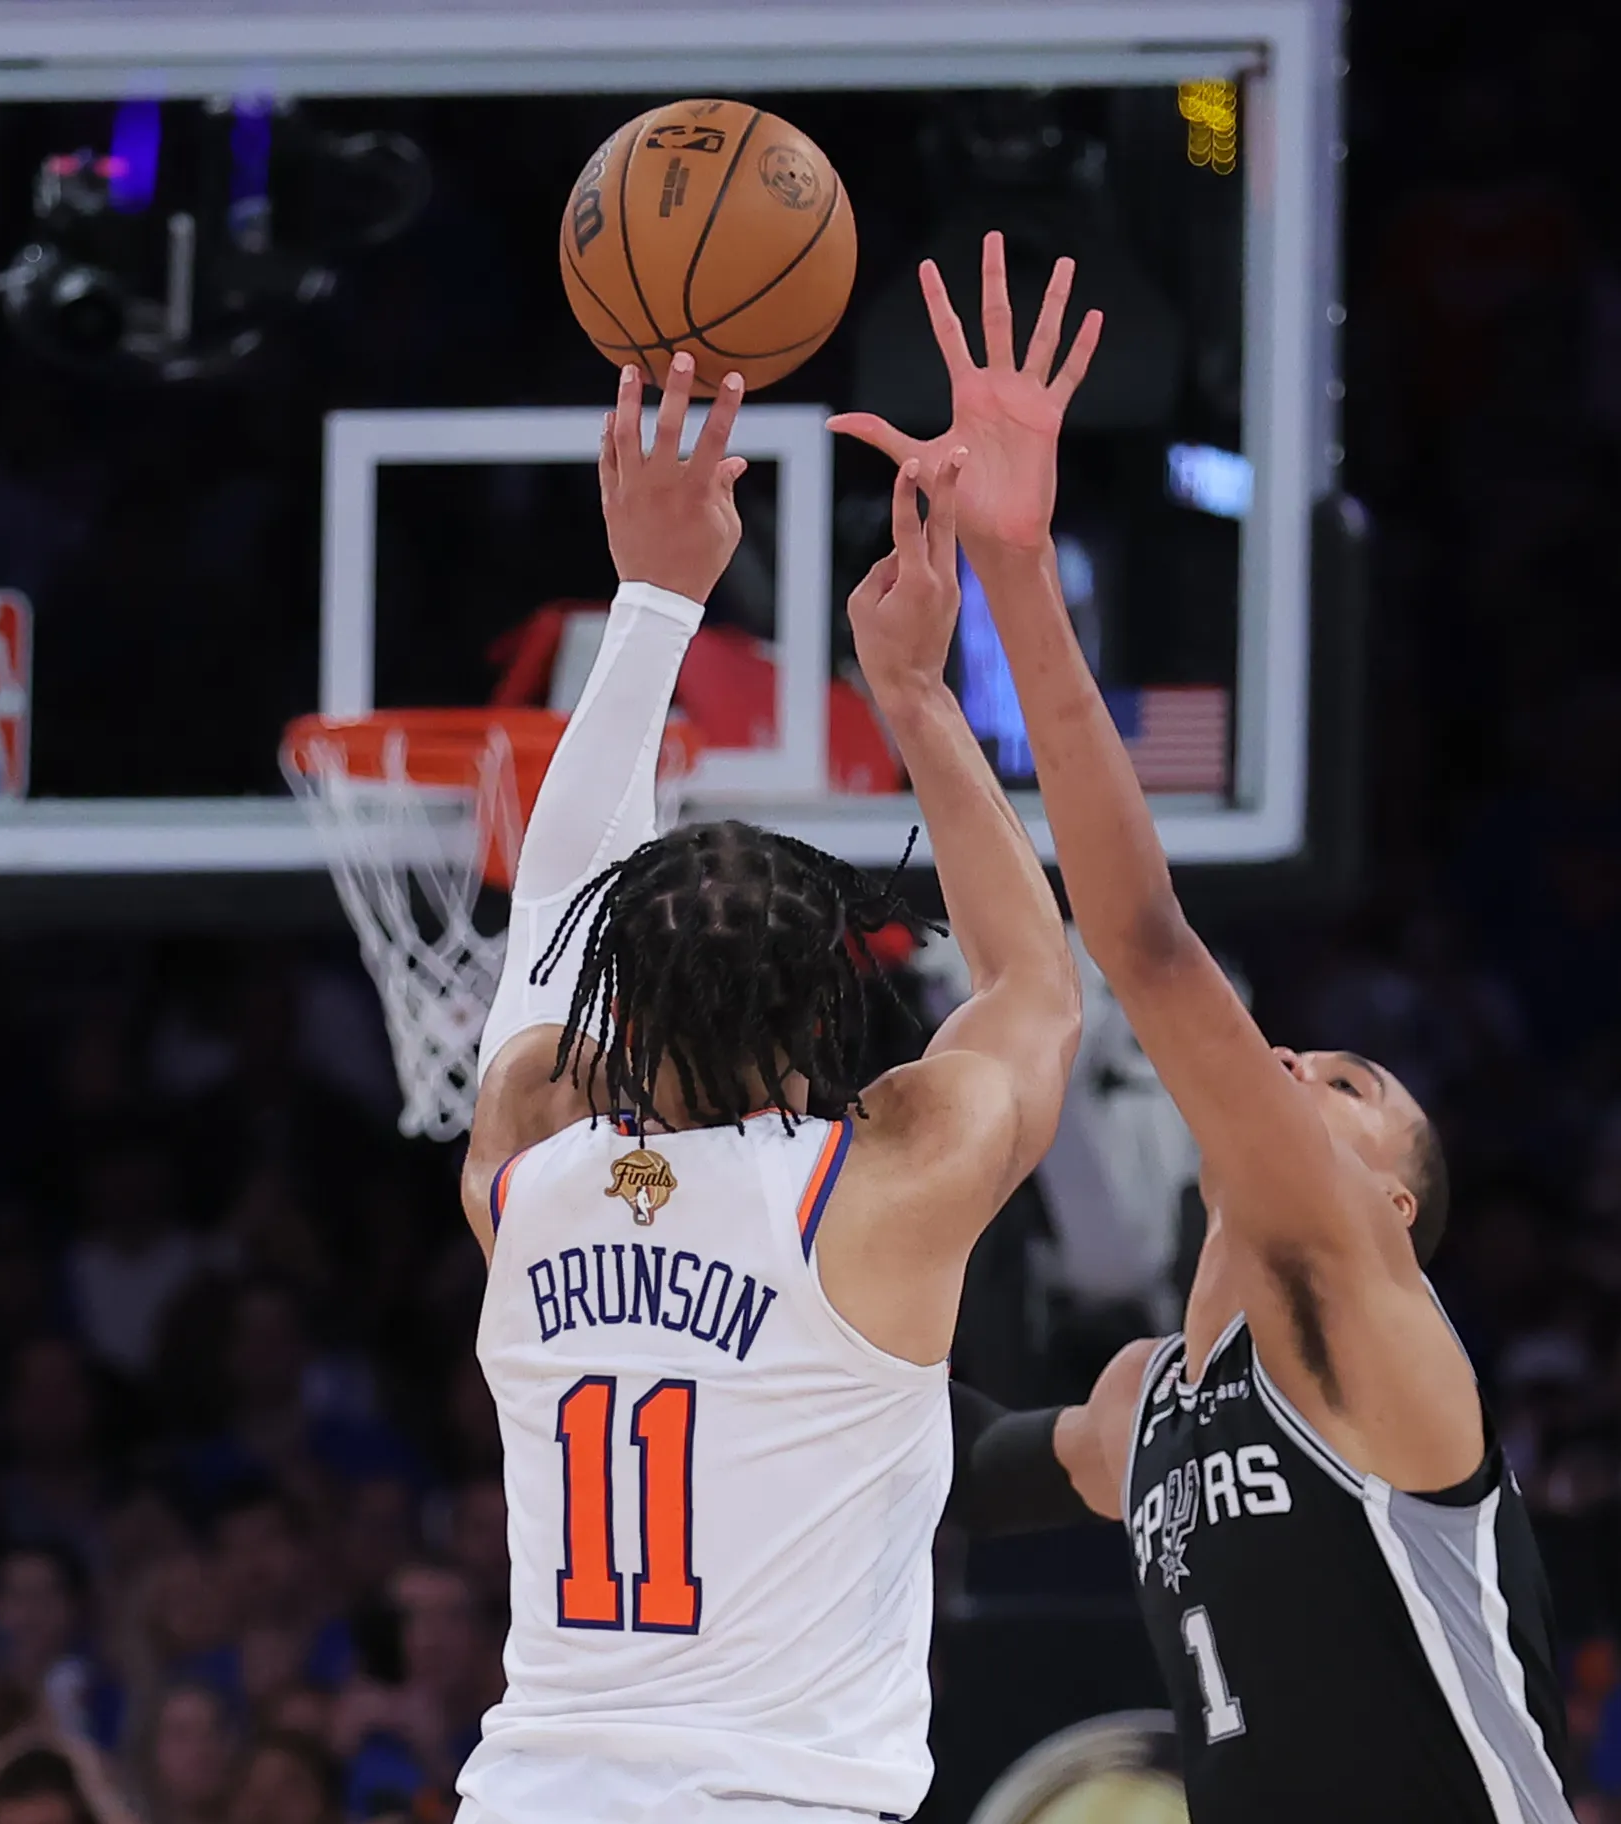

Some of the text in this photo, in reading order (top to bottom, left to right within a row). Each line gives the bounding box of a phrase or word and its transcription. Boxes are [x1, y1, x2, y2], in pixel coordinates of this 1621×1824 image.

[607, 1162, 675, 1194] Finals
[527, 1243, 778, 1362] BRUNSON
[555, 1375, 702, 1635] 11
[1180, 1604, 1247, 1745] 1
